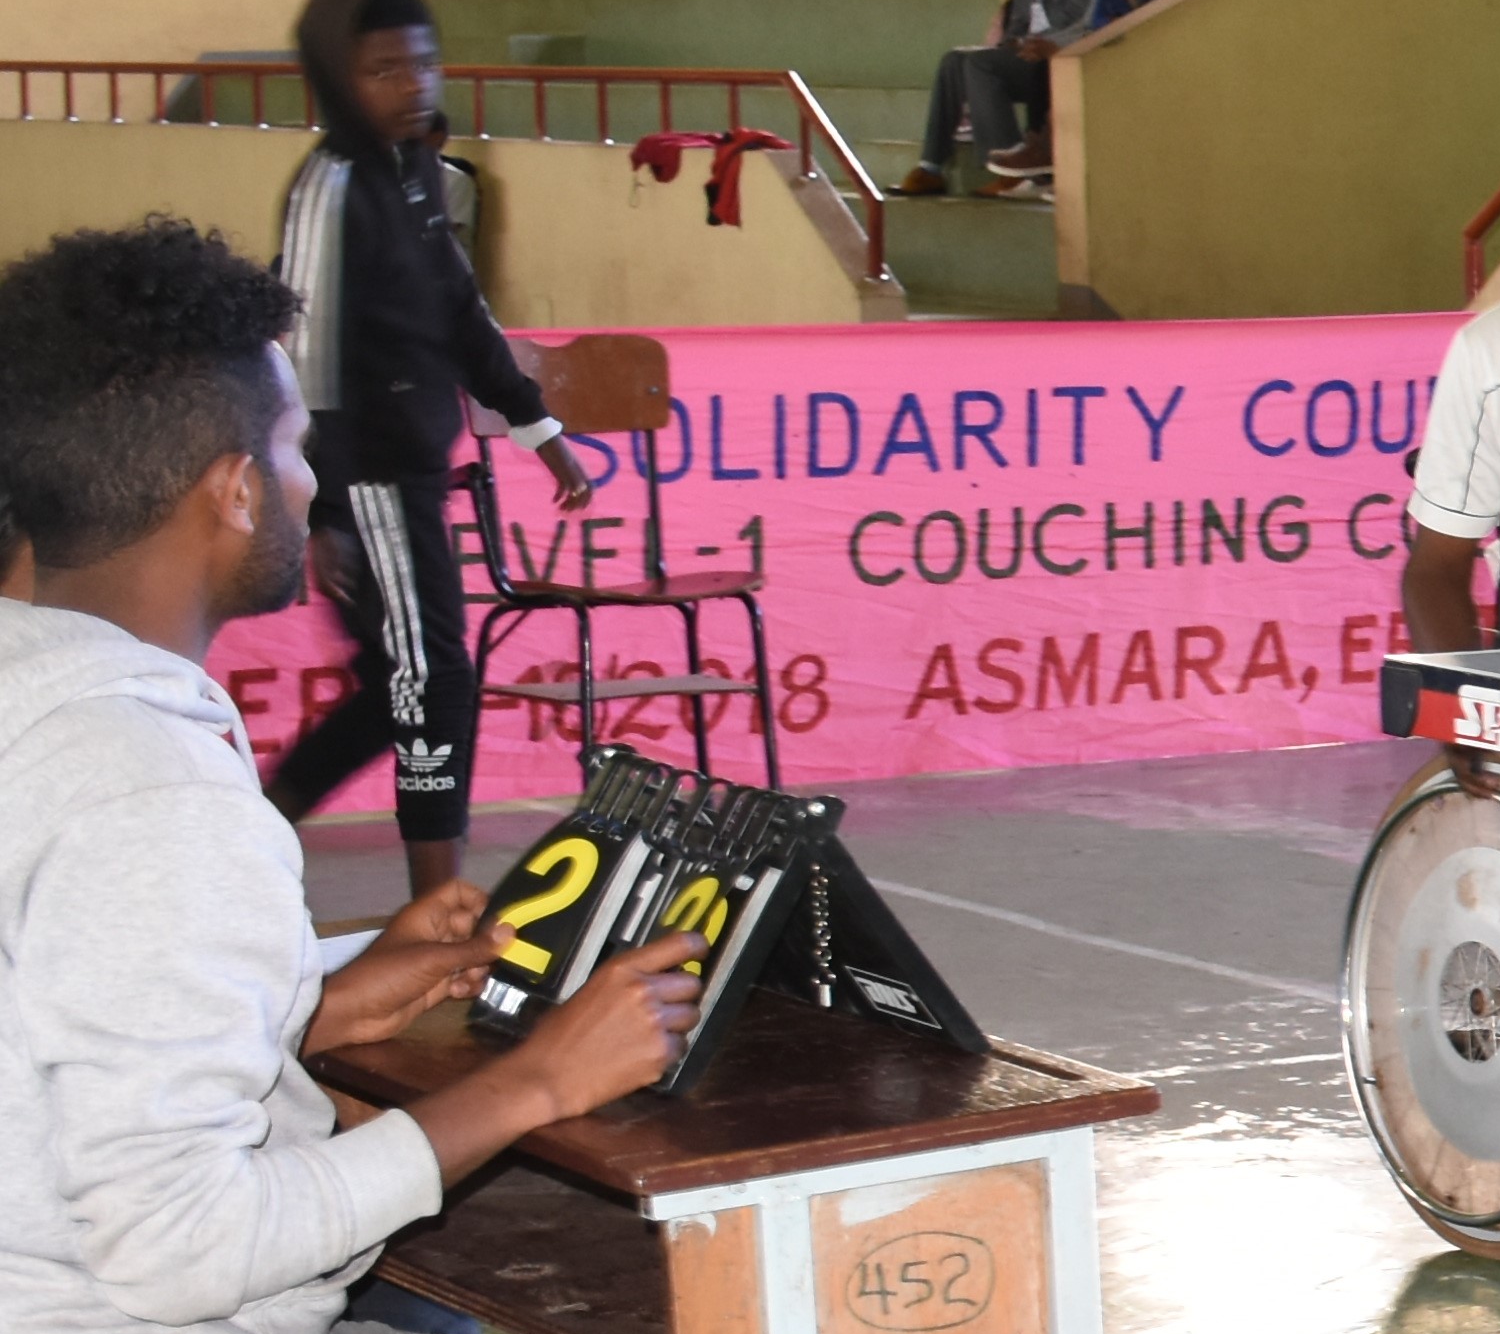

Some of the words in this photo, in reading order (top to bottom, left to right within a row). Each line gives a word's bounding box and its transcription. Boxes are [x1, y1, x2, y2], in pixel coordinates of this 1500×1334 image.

[1243, 376, 1438, 458] COU
[848, 494, 1312, 586] COUCHING
[1348, 493, 1416, 560] C
[905, 620, 1317, 720] ASMARA,
[499, 838, 599, 975] 2
[857, 1252, 979, 1316] 452
